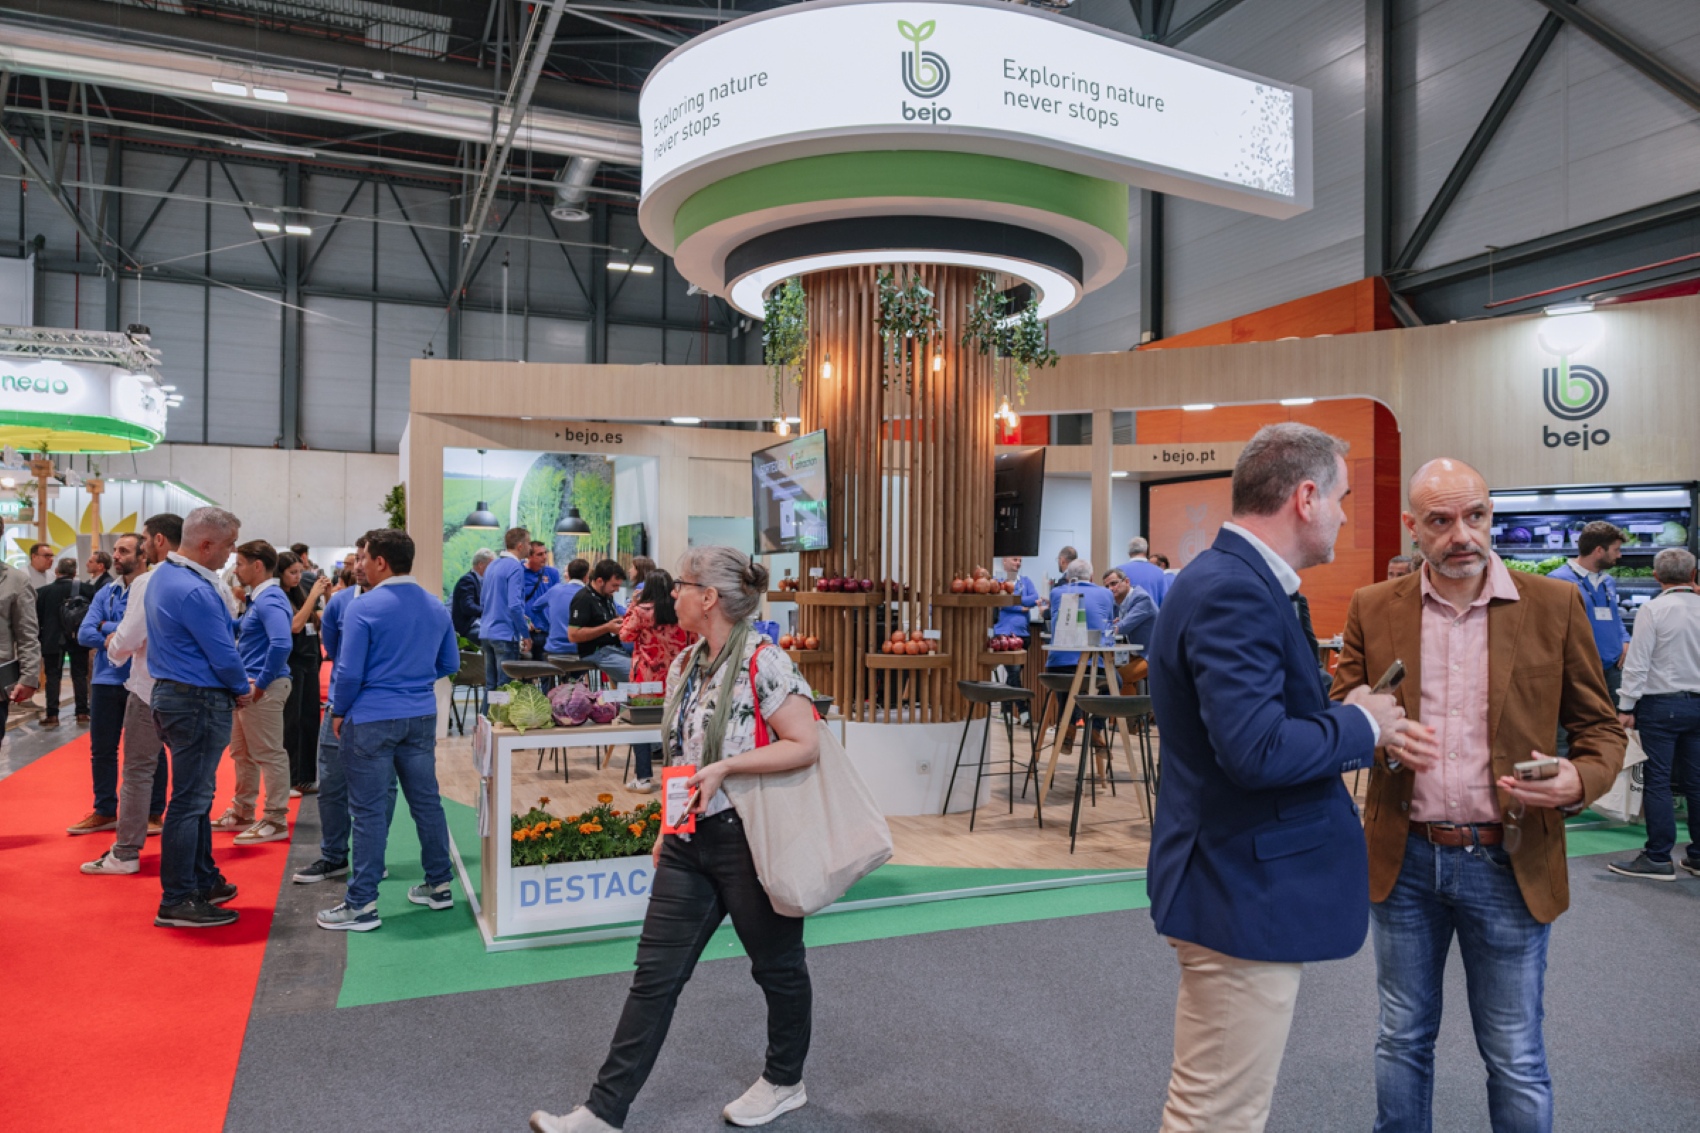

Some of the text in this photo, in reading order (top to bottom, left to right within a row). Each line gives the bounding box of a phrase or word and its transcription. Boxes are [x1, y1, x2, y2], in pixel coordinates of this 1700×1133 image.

[653, 71, 769, 138] Exploring nature
[1003, 58, 1165, 113] Exploring nature
[902, 100, 952, 124] bejo
[1004, 90, 1120, 129] never stops
[653, 112, 721, 161] never stops
[565, 427, 623, 446] bejo.es
[1542, 423, 1610, 451] bejo
[1162, 448, 1216, 465] bejo.pt
[520, 868, 653, 908] DESTAC
